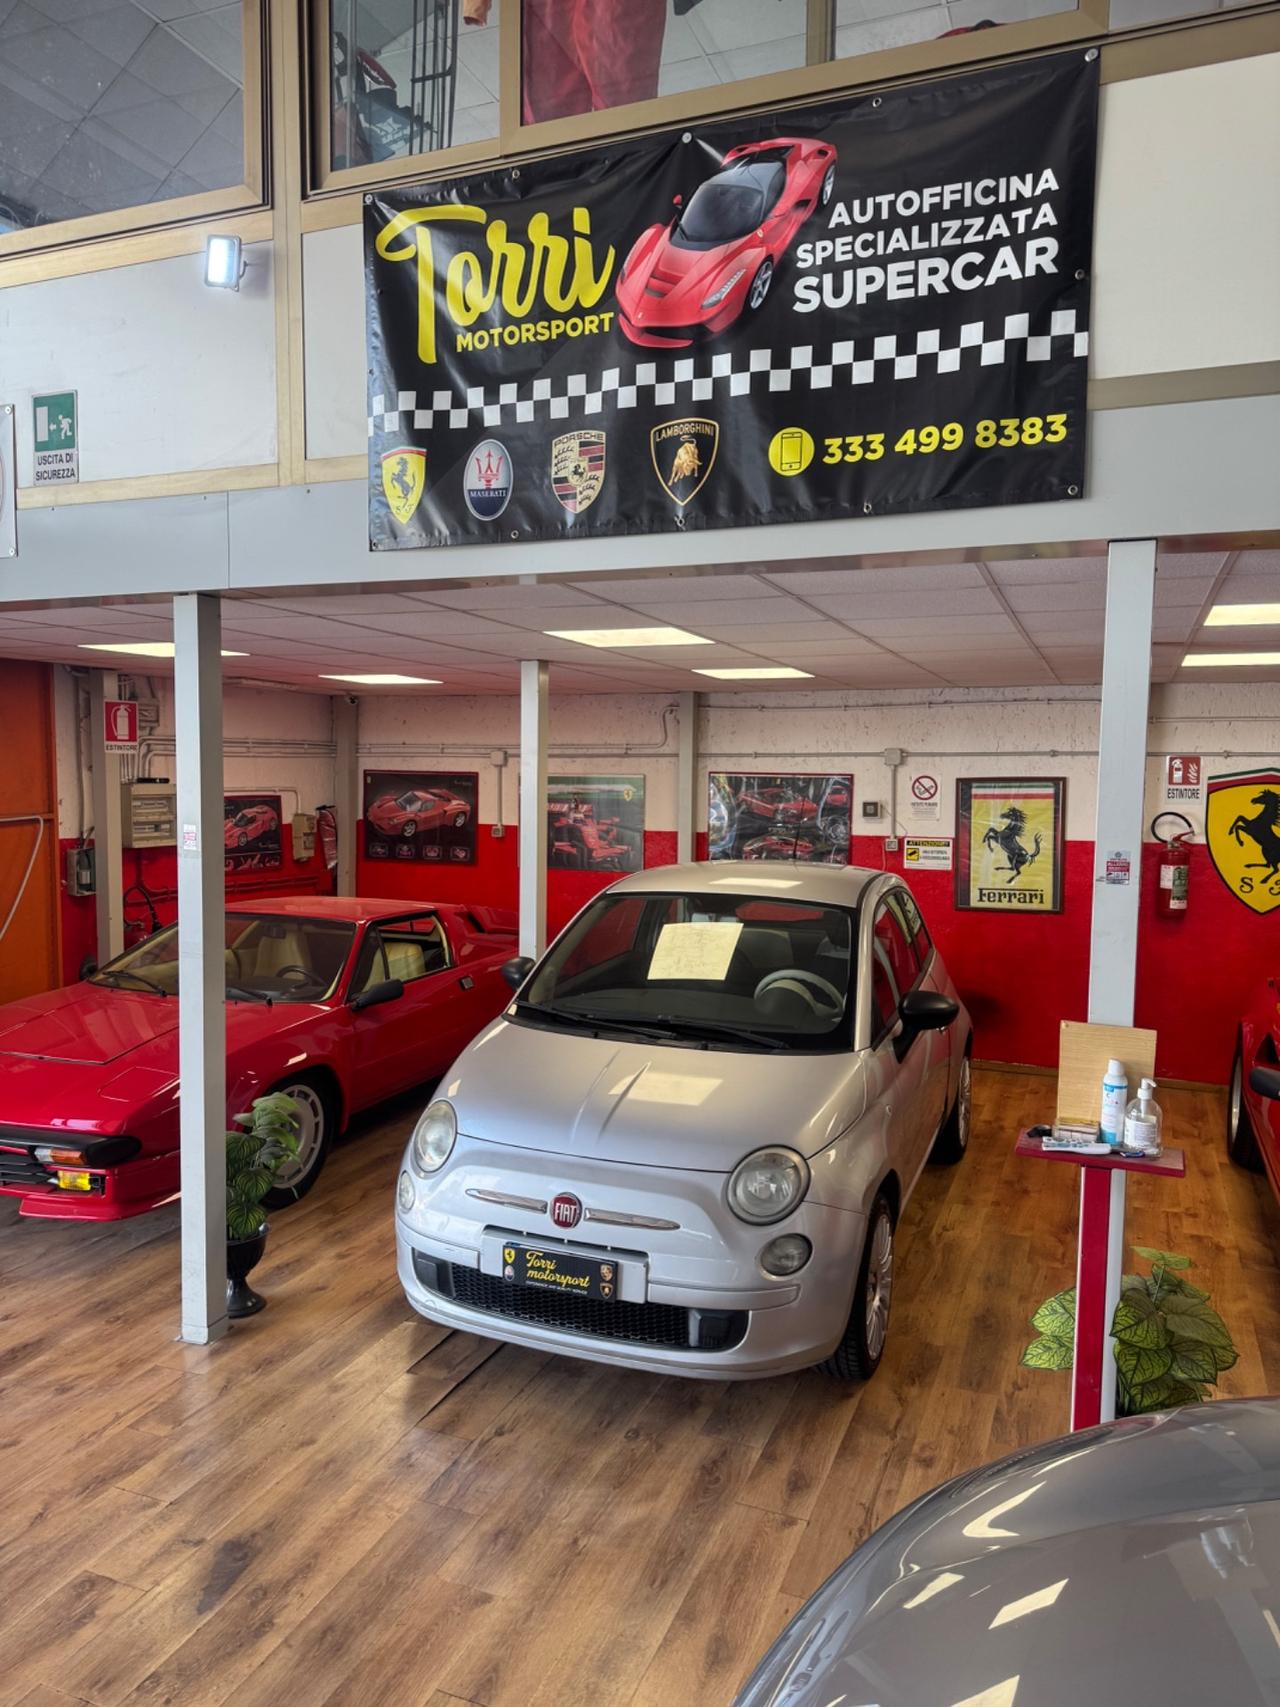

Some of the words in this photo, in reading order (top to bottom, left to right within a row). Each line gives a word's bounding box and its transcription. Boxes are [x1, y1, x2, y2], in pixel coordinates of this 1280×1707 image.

[828, 168, 1059, 229] AUTOFFICINA
[796, 202, 1058, 268] SPECIALIZZATA
[375, 204, 616, 364] Torri
[792, 236, 1059, 313] SUPERCAR
[456, 312, 614, 352] MOTORSPORT
[554, 432, 604, 447] PORSCHE
[655, 422, 715, 442] LAMBORGHINI
[822, 433, 885, 464] 333
[894, 422, 964, 455] 499
[975, 413, 1067, 449] 8383
[37, 453, 64, 466] USCITA
[65, 452, 74, 463] DI
[35, 467, 76, 481] SICUREZZA
[470, 490, 508, 498] MASERATI
[1167, 788, 1200, 799] ESTINTORE
[1239, 876, 1254, 894] S
[977, 888, 1044, 904] Ferrari
[554, 1202, 577, 1223] FIAT
[525, 1250, 557, 1269] Torri
[527, 1270, 590, 1287] motorsport
